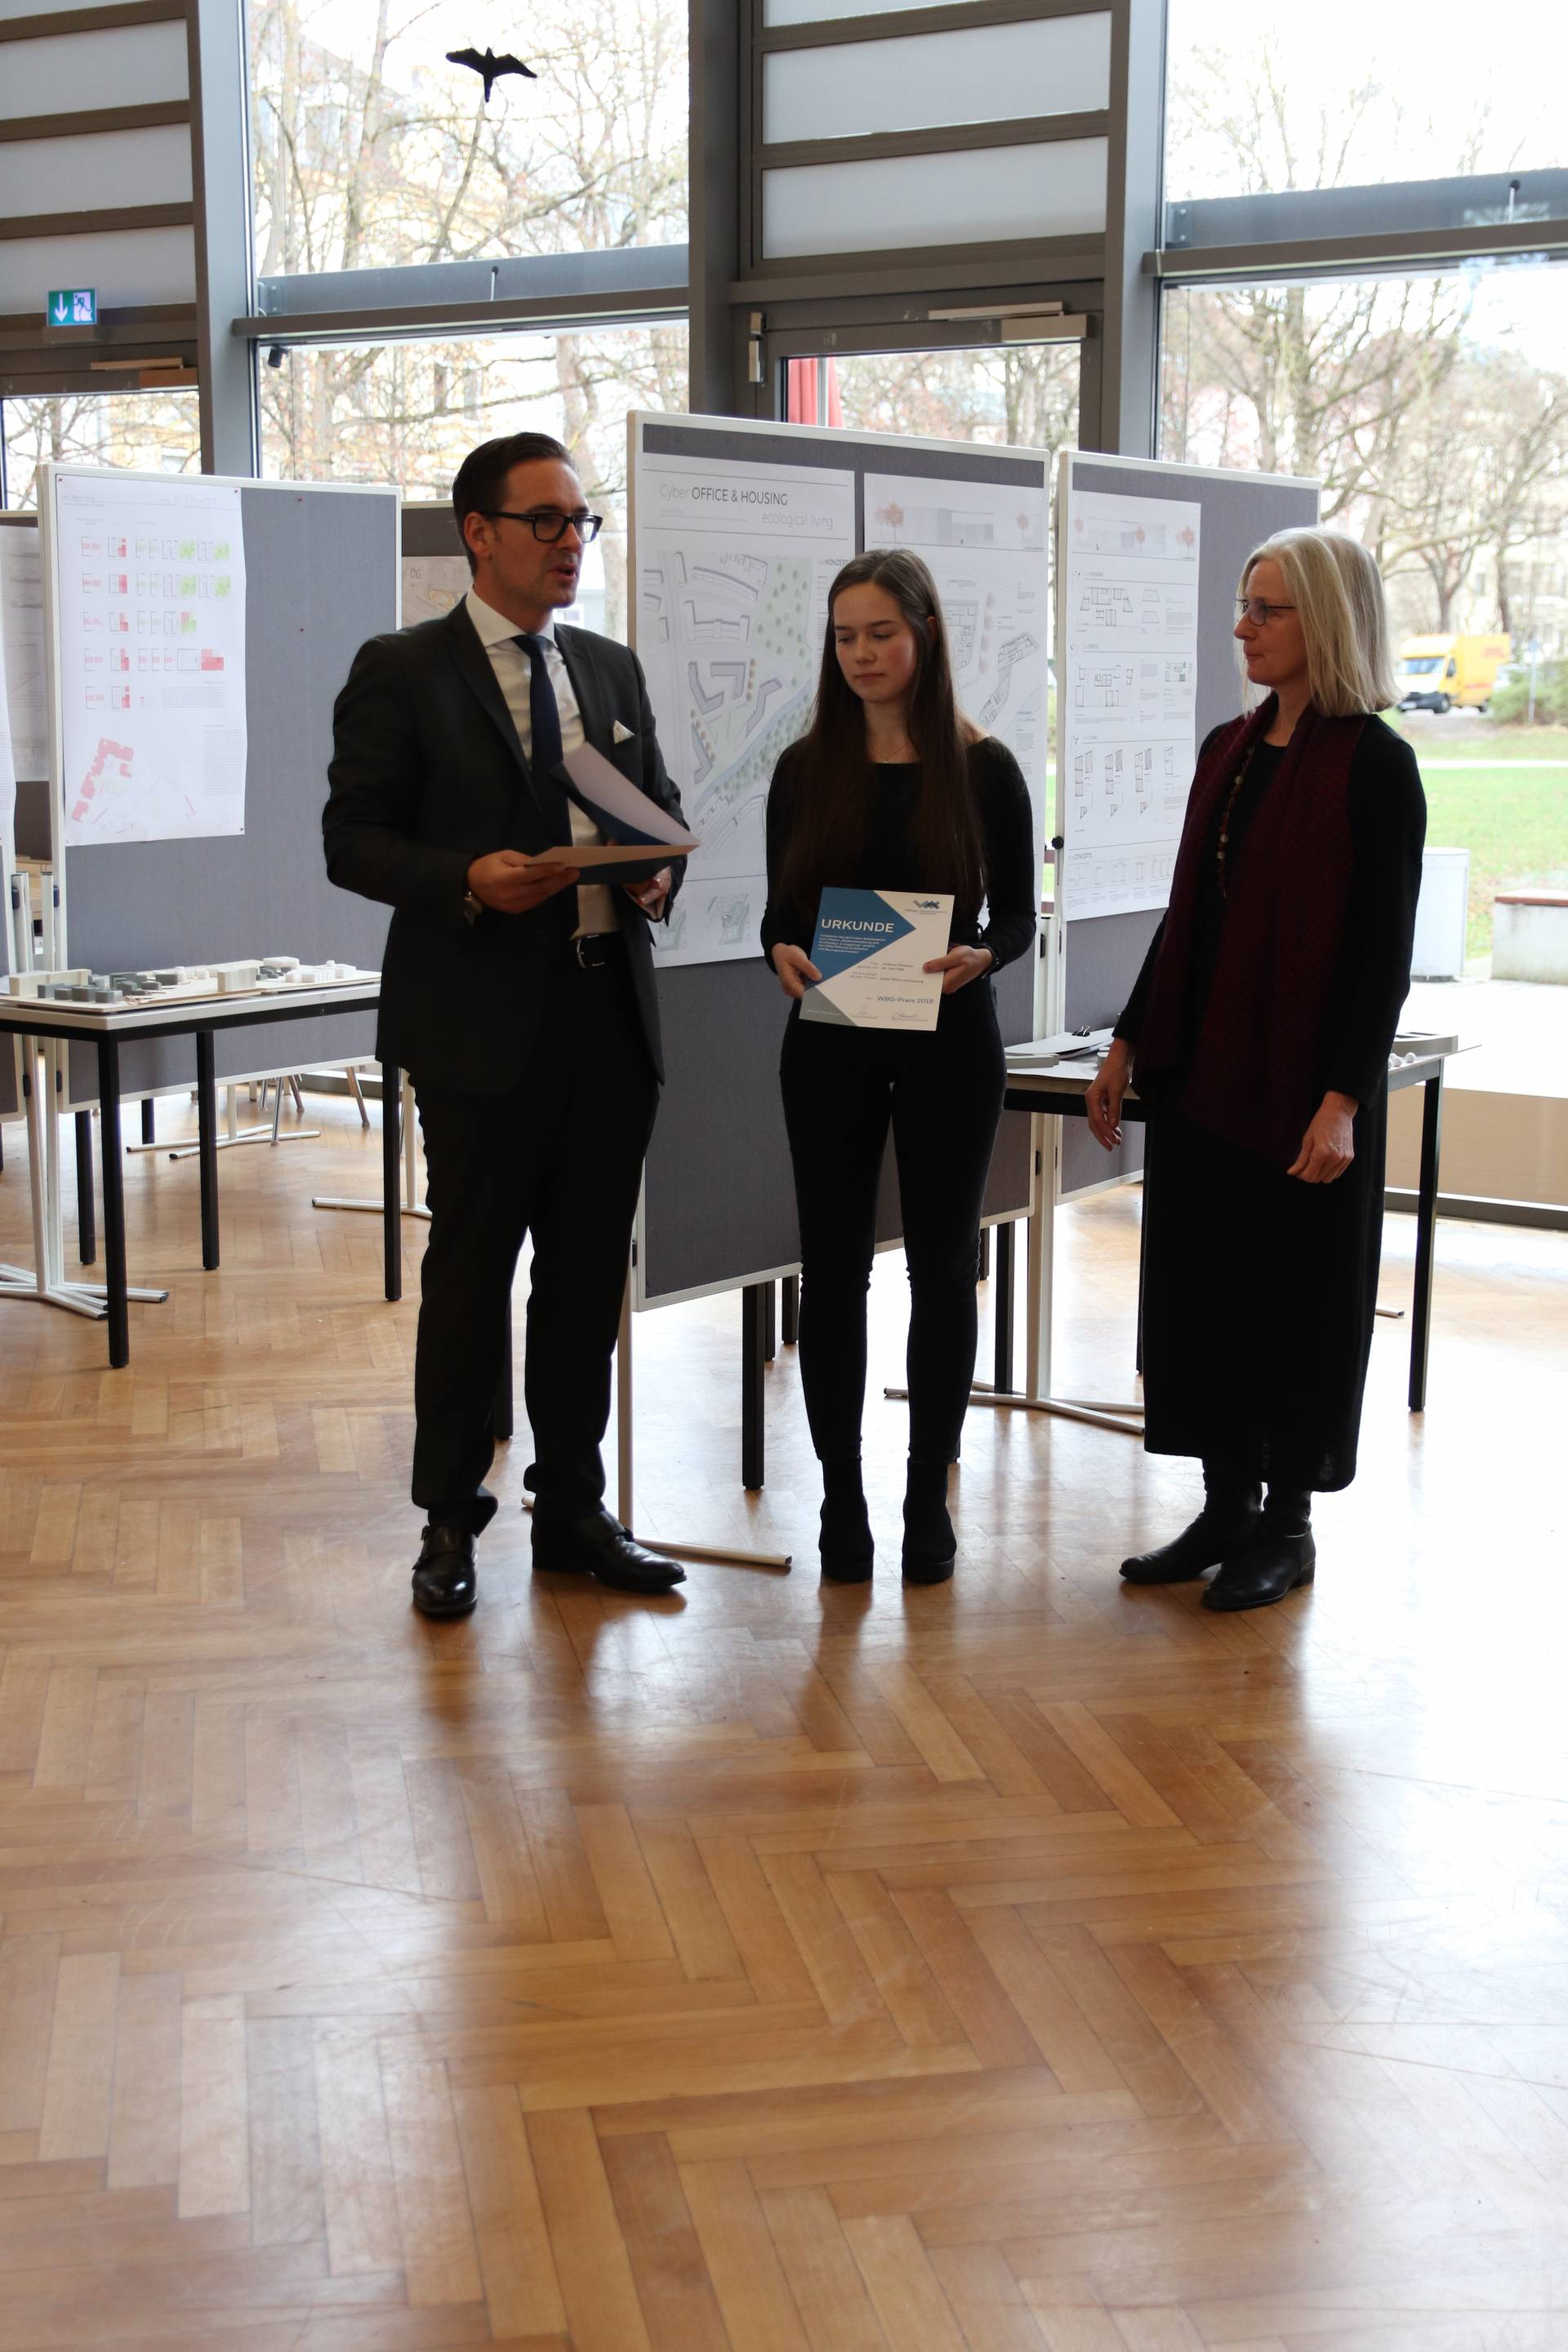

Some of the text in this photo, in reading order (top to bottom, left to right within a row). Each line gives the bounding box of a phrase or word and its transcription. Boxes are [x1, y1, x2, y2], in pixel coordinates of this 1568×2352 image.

[659, 484, 788, 506] Cyber OFFICE & HOUSING
[761, 512, 808, 527] ecological
[810, 515, 834, 530] living
[821, 919, 895, 933] URKUNDE
